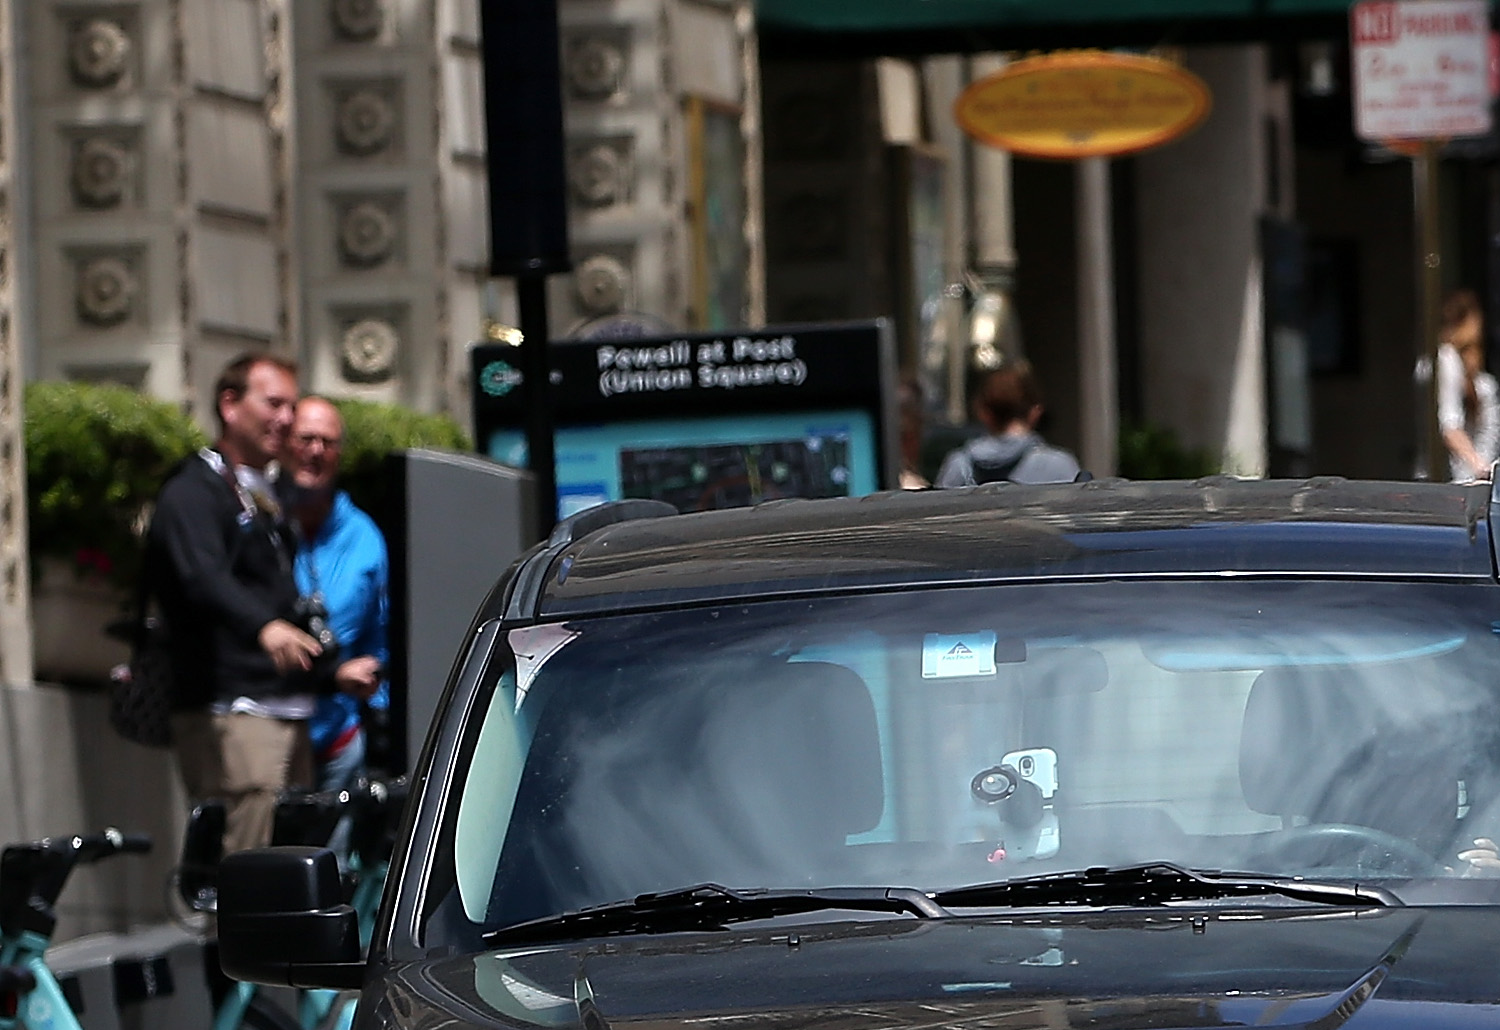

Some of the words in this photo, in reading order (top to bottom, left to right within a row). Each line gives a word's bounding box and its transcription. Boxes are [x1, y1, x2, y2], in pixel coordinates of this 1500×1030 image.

[598, 340, 691, 370] Powell
[698, 341, 726, 364] at
[733, 336, 796, 361] Post
[600, 368, 692, 397] (Union
[698, 359, 807, 389] Square)
